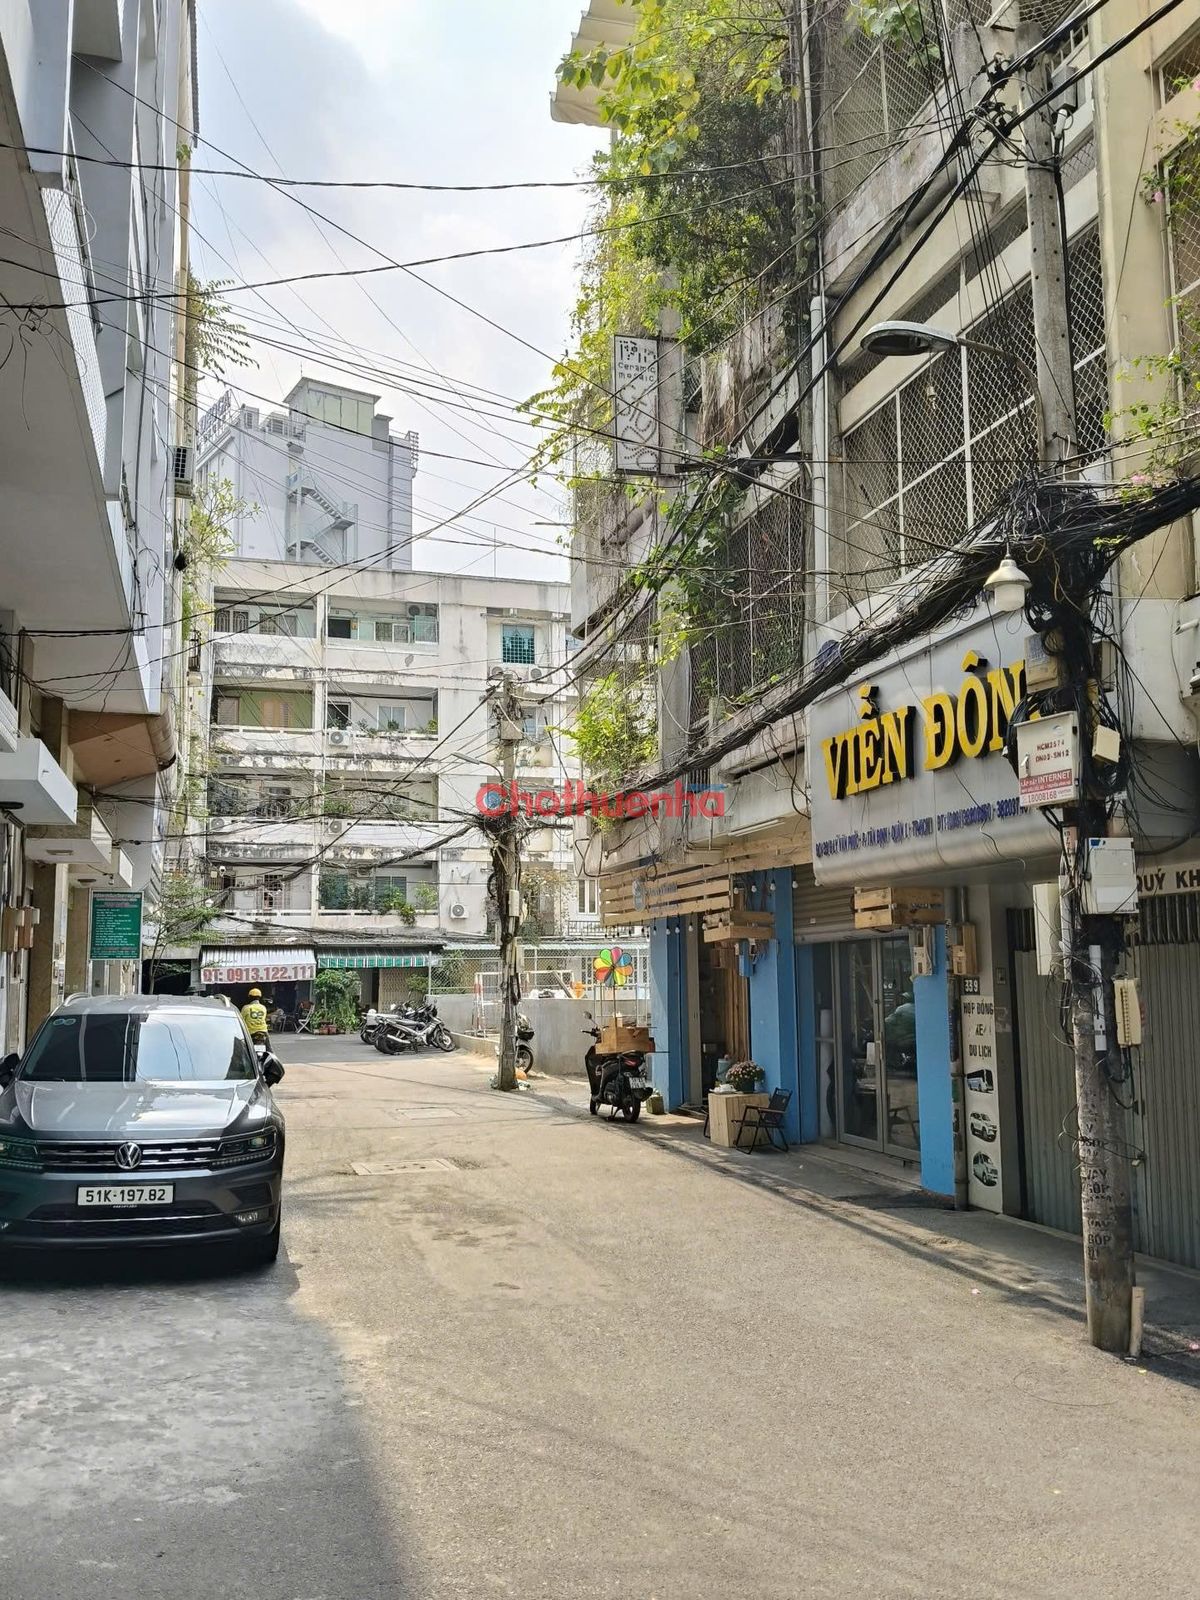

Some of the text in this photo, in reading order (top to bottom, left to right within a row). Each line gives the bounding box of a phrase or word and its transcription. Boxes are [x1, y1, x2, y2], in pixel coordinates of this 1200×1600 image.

[923, 649, 1040, 771] ĐÔN
[1037, 771, 1071, 784] INTERNET
[226, 965, 314, 982] 0913.122.111
[964, 979, 979, 993] 339
[249, 1008, 265, 1020] be
[968, 1044, 978, 1057] DU
[86, 1189, 166, 1203] 51K-197.82
